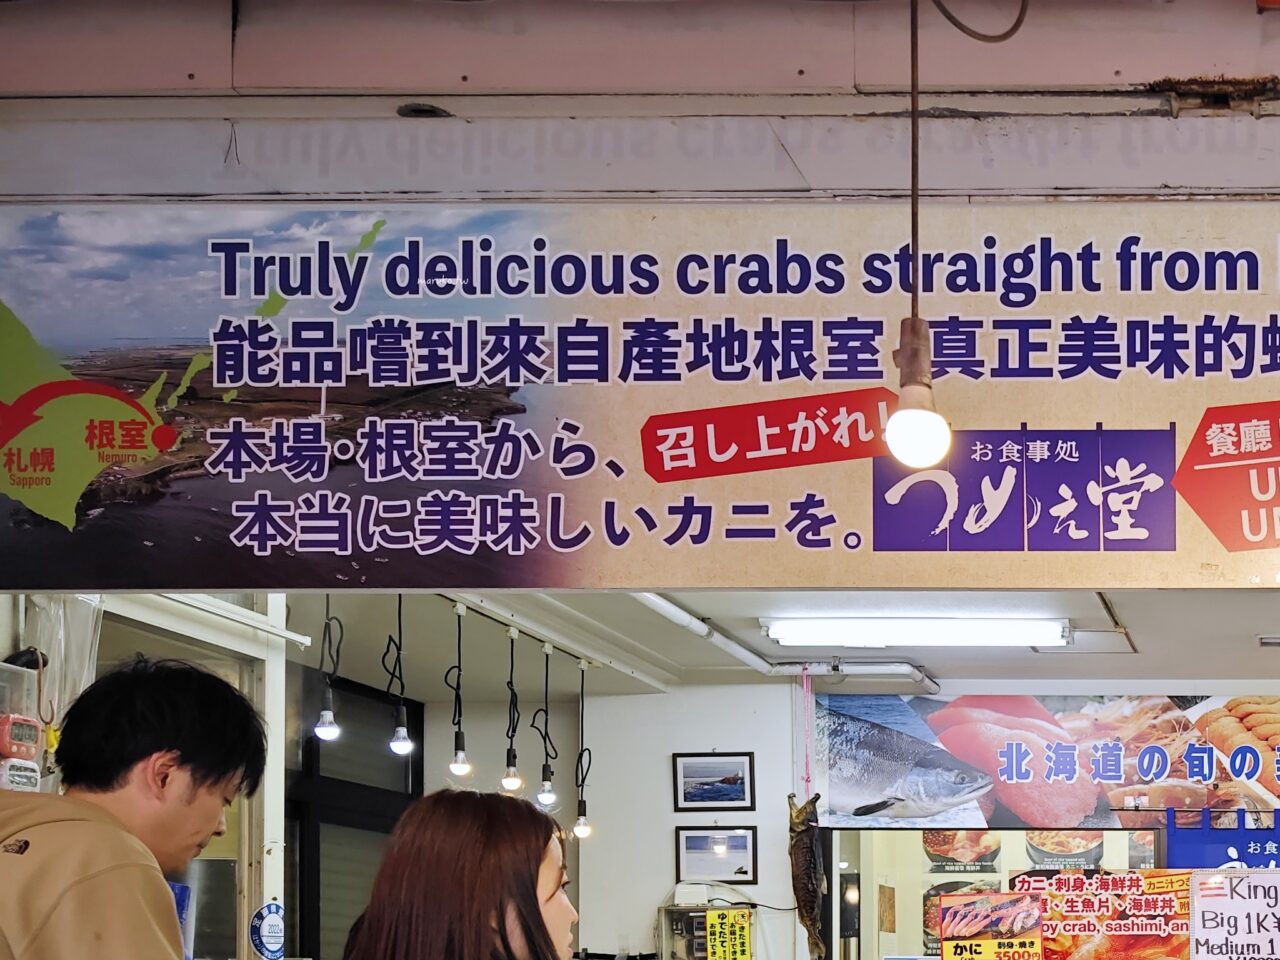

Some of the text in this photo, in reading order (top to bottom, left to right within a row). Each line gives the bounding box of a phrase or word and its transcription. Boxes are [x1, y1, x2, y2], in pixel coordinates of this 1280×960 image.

[211, 241, 369, 312] Truly
[385, 238, 659, 295] delicious
[676, 239, 845, 294] crabs
[862, 236, 1101, 308] straight
[1116, 236, 1259, 291] from
[85, 419, 148, 450] 根室
[1205, 418, 1272, 457] 餐廳
[3, 448, 55, 473] 札幌
[98, 451, 137, 463] Nemuro
[970, 440, 1080, 463] お食事処
[9, 474, 51, 488] Sapporo
[232, 491, 862, 554] 本当に美味しいカニを。
[1229, 876, 1279, 908] King
[717, 912, 728, 949] ゆでたて
[1063, 919, 1100, 934] crab,
[1105, 919, 1166, 935] sashimi,
[1201, 910, 1239, 936] Big
[953, 943, 983, 956] かに
[1194, 936, 1261, 956] Medium
